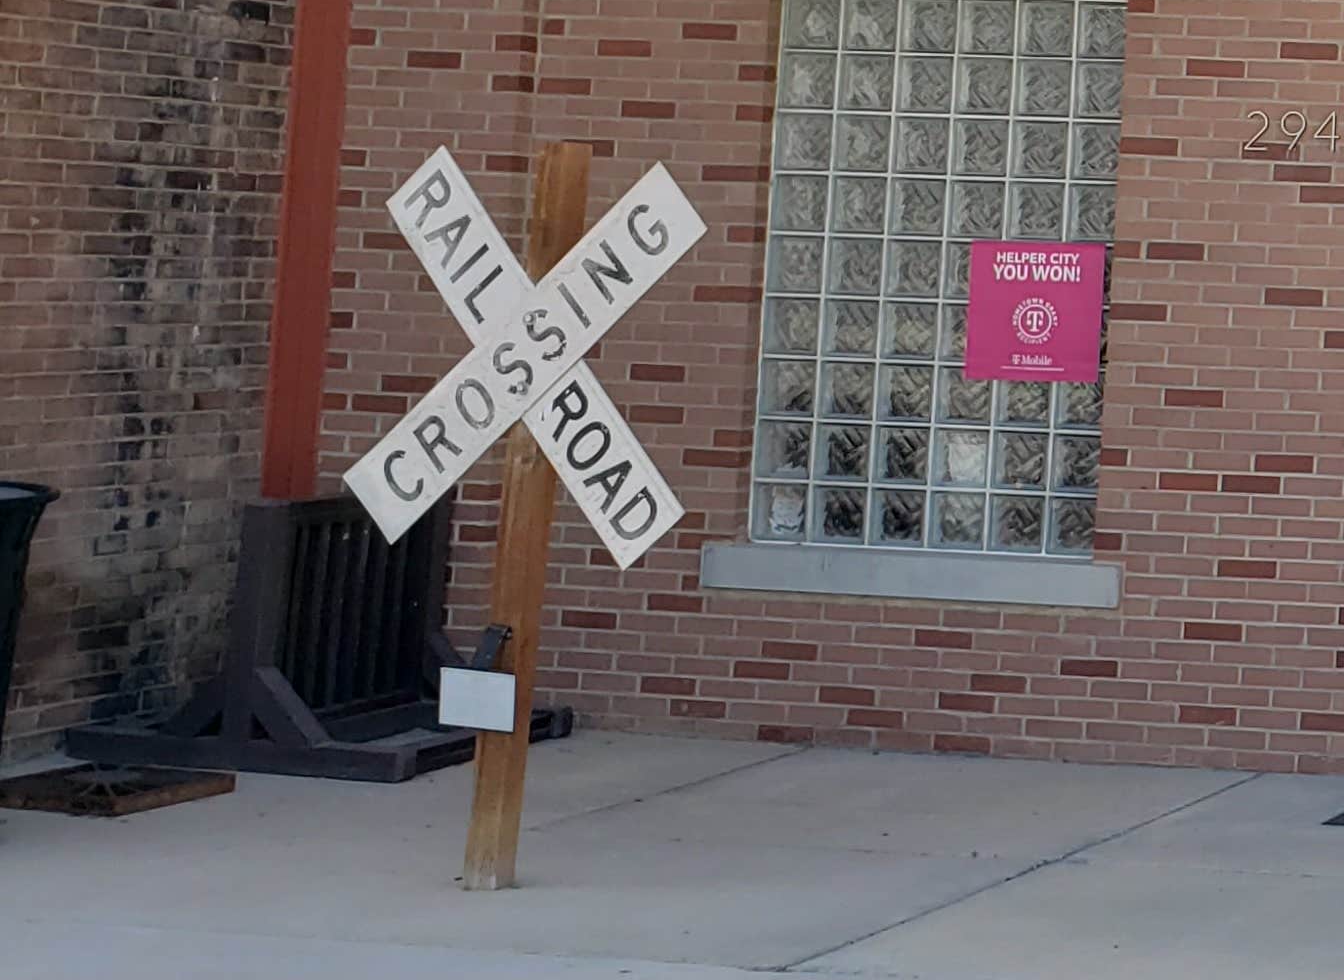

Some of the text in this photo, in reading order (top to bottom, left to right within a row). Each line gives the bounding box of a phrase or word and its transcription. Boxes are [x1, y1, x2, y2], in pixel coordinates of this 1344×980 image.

[1244, 110, 1339, 153] 294
[403, 168, 504, 325] RAIL
[996, 251, 1080, 265] HELPER CITY
[993, 264, 1081, 282] YOU WON!
[1026, 310, 1044, 333] T
[383, 203, 670, 503] CROSSING
[550, 378, 658, 541] ROAD
